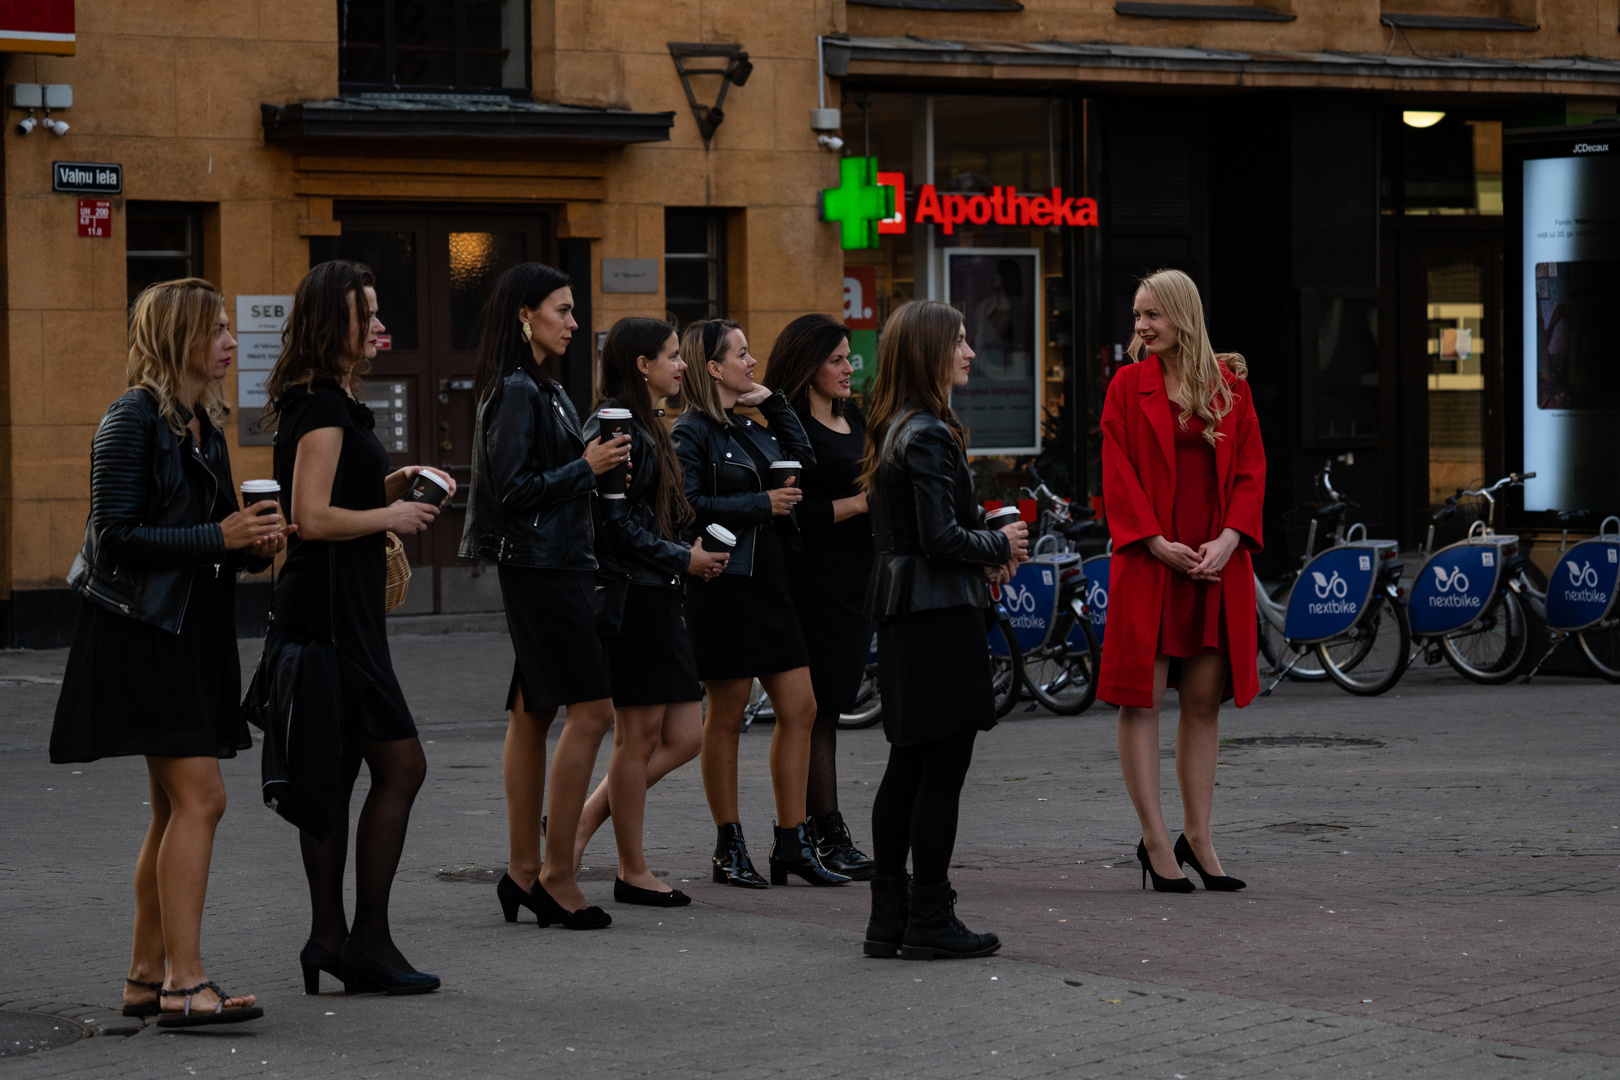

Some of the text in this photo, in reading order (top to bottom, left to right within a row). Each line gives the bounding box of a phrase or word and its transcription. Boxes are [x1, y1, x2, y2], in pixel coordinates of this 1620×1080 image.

[1572, 143, 1609, 154] JCDecaux
[59, 167, 117, 186] Vaļņu iela
[94, 207, 109, 218] 200
[914, 184, 1099, 236] Apotheka
[87, 227, 103, 236] 11.0
[250, 304, 284, 318] SEB
[1428, 593, 1481, 608] nextbike
[1564, 587, 1607, 603] nextbike
[1308, 599, 1357, 615] nextbike
[1010, 612, 1046, 629] extbike
